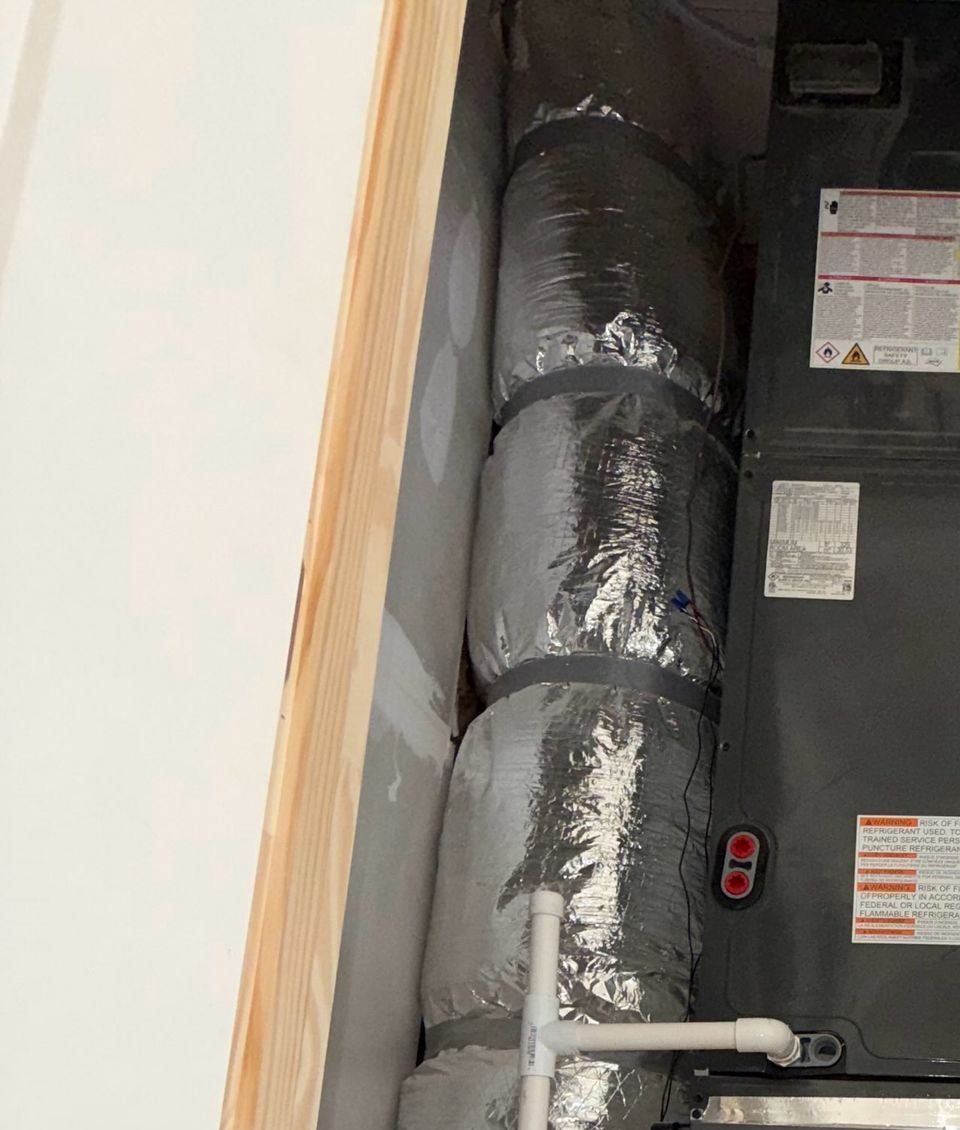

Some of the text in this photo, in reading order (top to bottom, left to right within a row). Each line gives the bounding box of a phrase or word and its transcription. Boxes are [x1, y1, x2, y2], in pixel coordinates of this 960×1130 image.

[919, 820, 938, 828] RISK
[941, 820, 953, 828] OF
[862, 828, 920, 836] REFRIGERANT
[862, 835, 899, 844] TRAINED
[899, 836, 936, 844] SERVICE
[862, 844, 907, 852] PUNCTURE
[918, 884, 938, 892] RISK
[939, 885, 951, 893] OF
[918, 893, 927, 901] IN
[860, 901, 898, 909] FEDERAL
[899, 901, 913, 909] OR
[914, 902, 943, 910] LOCAL
[859, 909, 910, 918] FLAMMABLE
